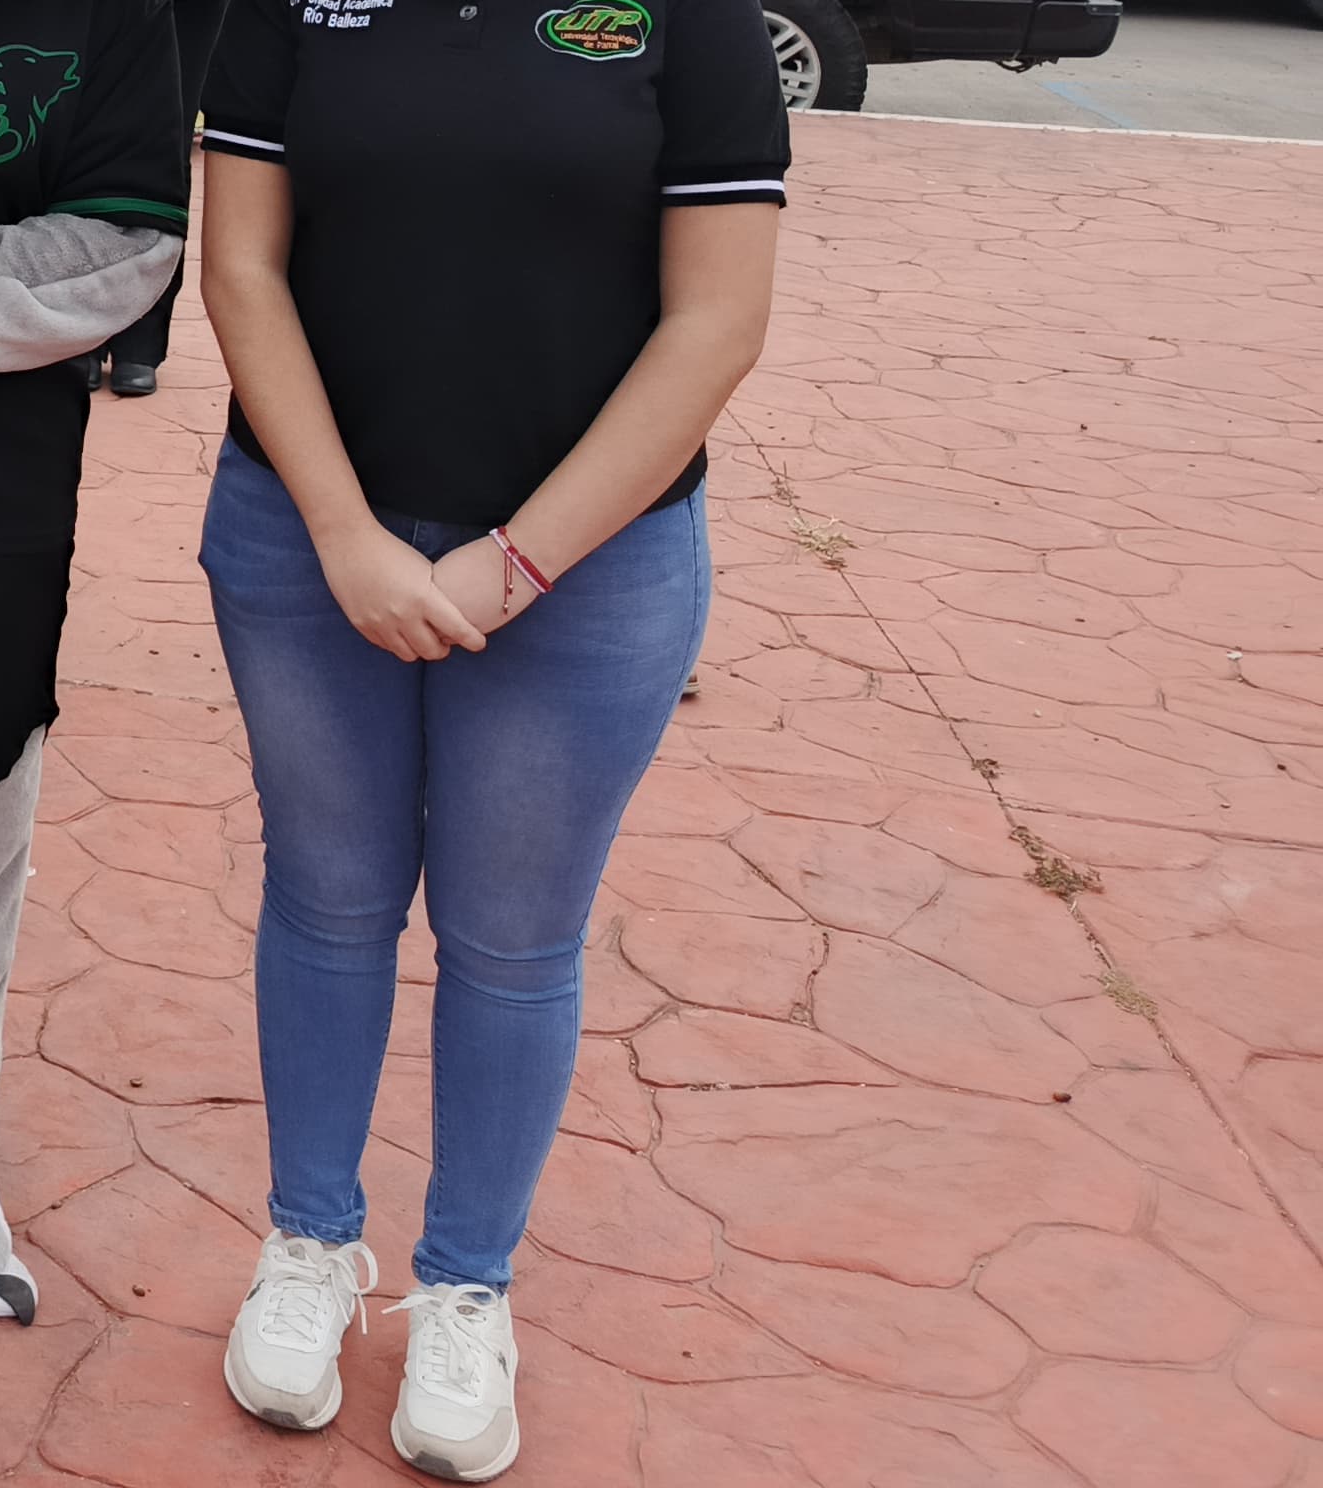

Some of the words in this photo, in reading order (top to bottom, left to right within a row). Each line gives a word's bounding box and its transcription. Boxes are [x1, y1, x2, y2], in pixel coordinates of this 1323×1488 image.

[303, 5, 324, 24] Río
[328, 12, 371, 28] Balleza
[554, 9, 642, 31] UTP
